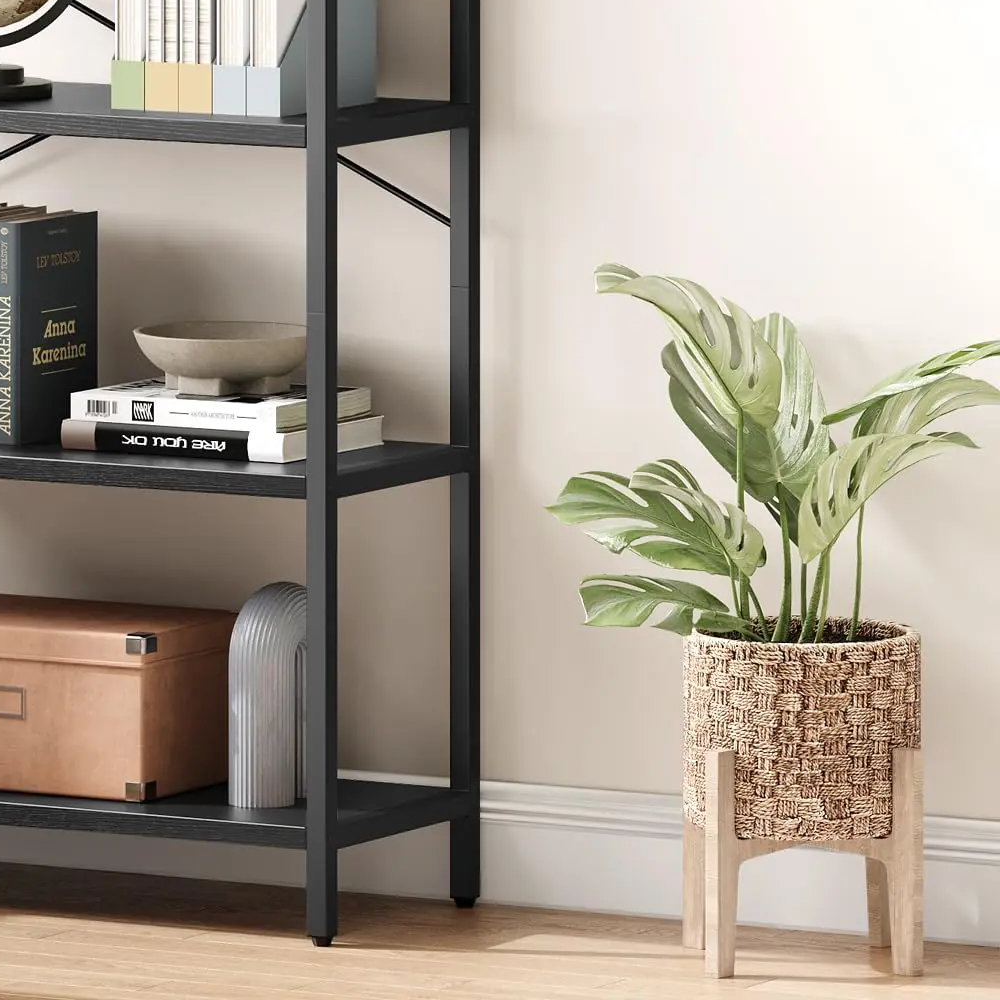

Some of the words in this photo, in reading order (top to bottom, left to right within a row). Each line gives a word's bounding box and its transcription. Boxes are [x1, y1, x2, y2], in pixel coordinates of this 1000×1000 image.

[44, 318, 75, 339] Anna
[32, 342, 86, 366] Karenina
[133, 401, 154, 421] MARK
